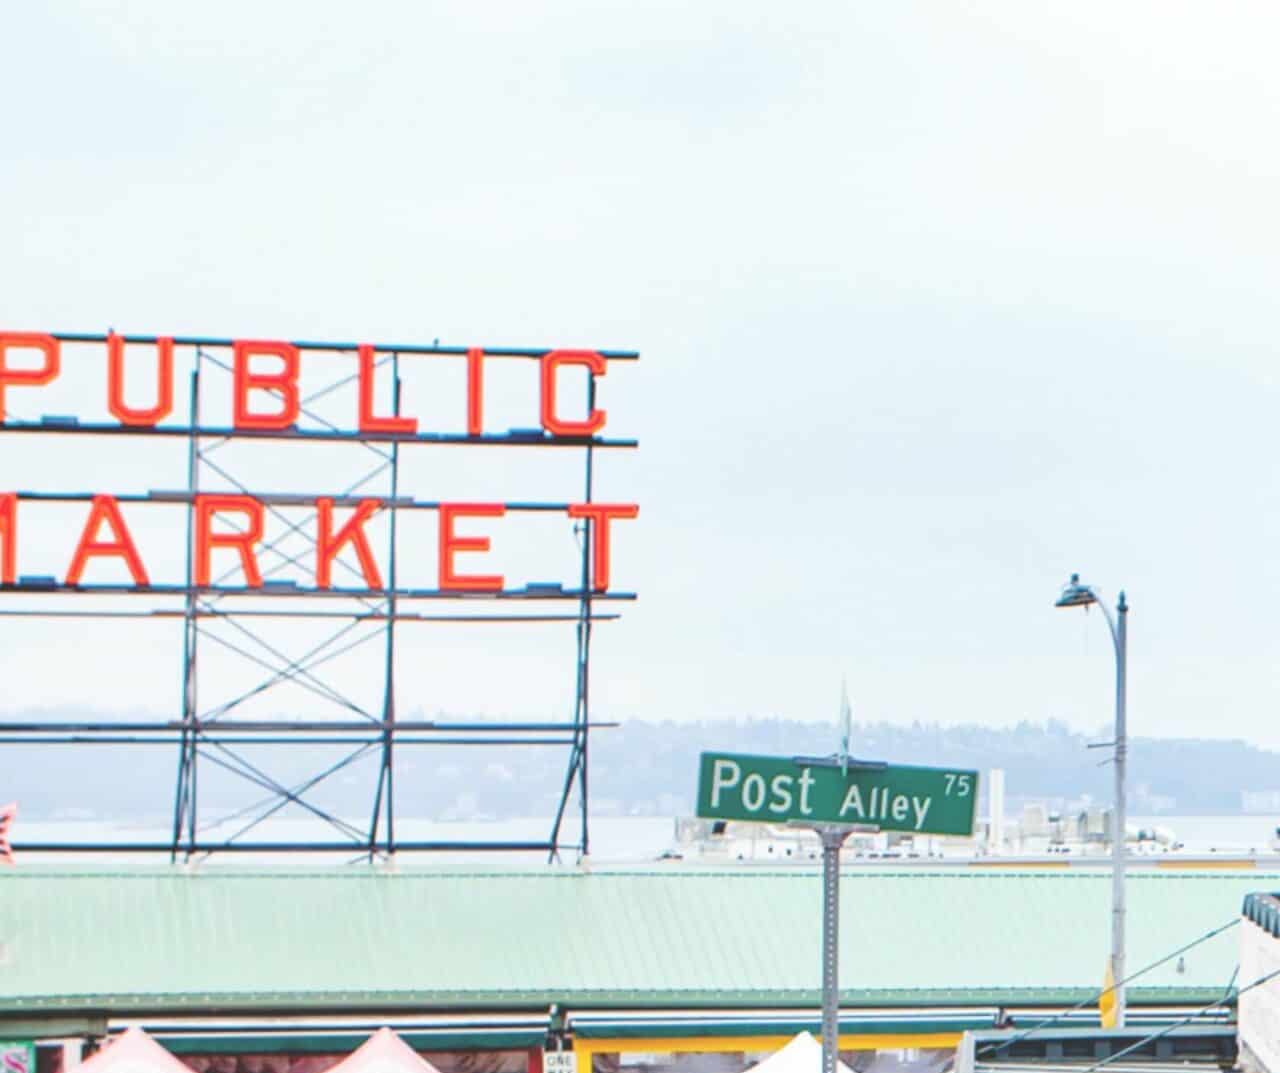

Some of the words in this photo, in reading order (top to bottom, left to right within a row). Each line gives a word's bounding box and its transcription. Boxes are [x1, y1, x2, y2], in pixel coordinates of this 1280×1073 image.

[0, 332, 607, 436] PUBLIC
[710, 759, 815, 815] Post
[839, 784, 931, 830] Alley
[944, 773, 971, 797] 75
[547, 1055, 572, 1066] ONE
